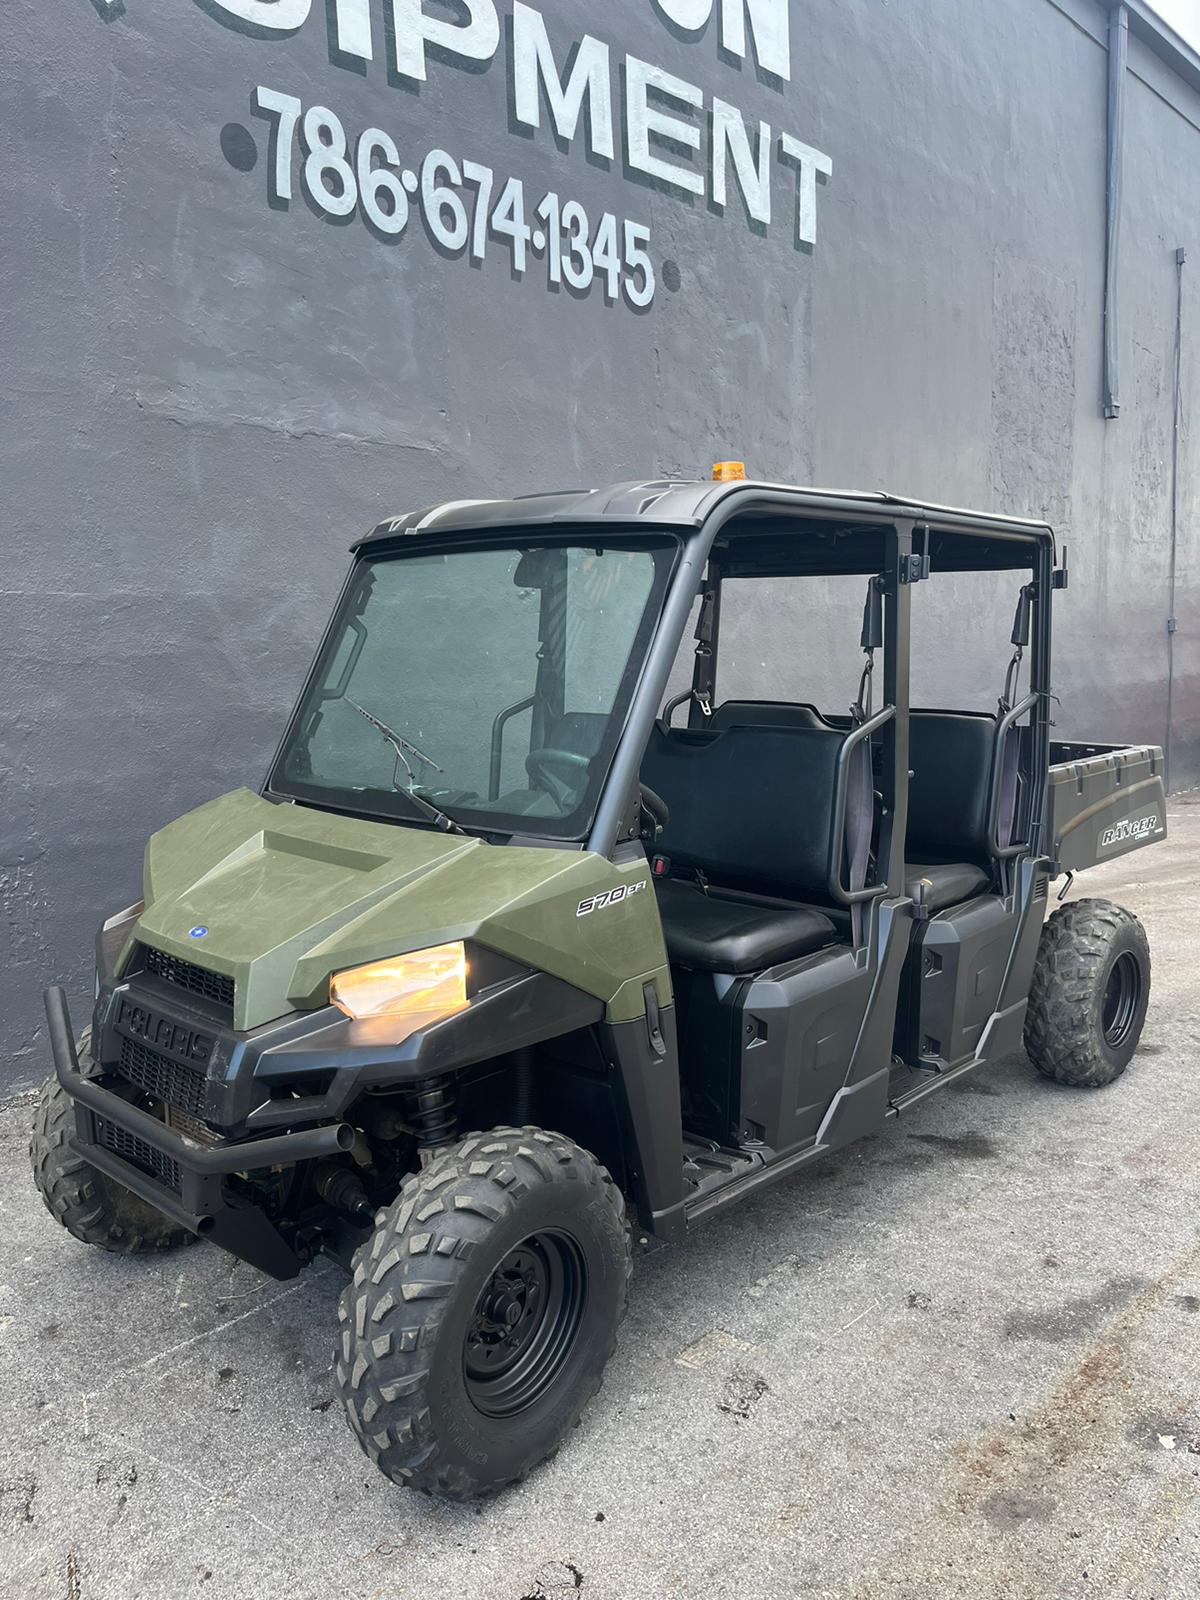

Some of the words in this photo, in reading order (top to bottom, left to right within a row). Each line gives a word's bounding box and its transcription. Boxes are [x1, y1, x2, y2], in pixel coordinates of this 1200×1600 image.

[1102, 815, 1157, 846] RANGER
[576, 885, 627, 917] 570
[627, 880, 647, 895] EFI
[118, 998, 212, 1061] POLARIS
